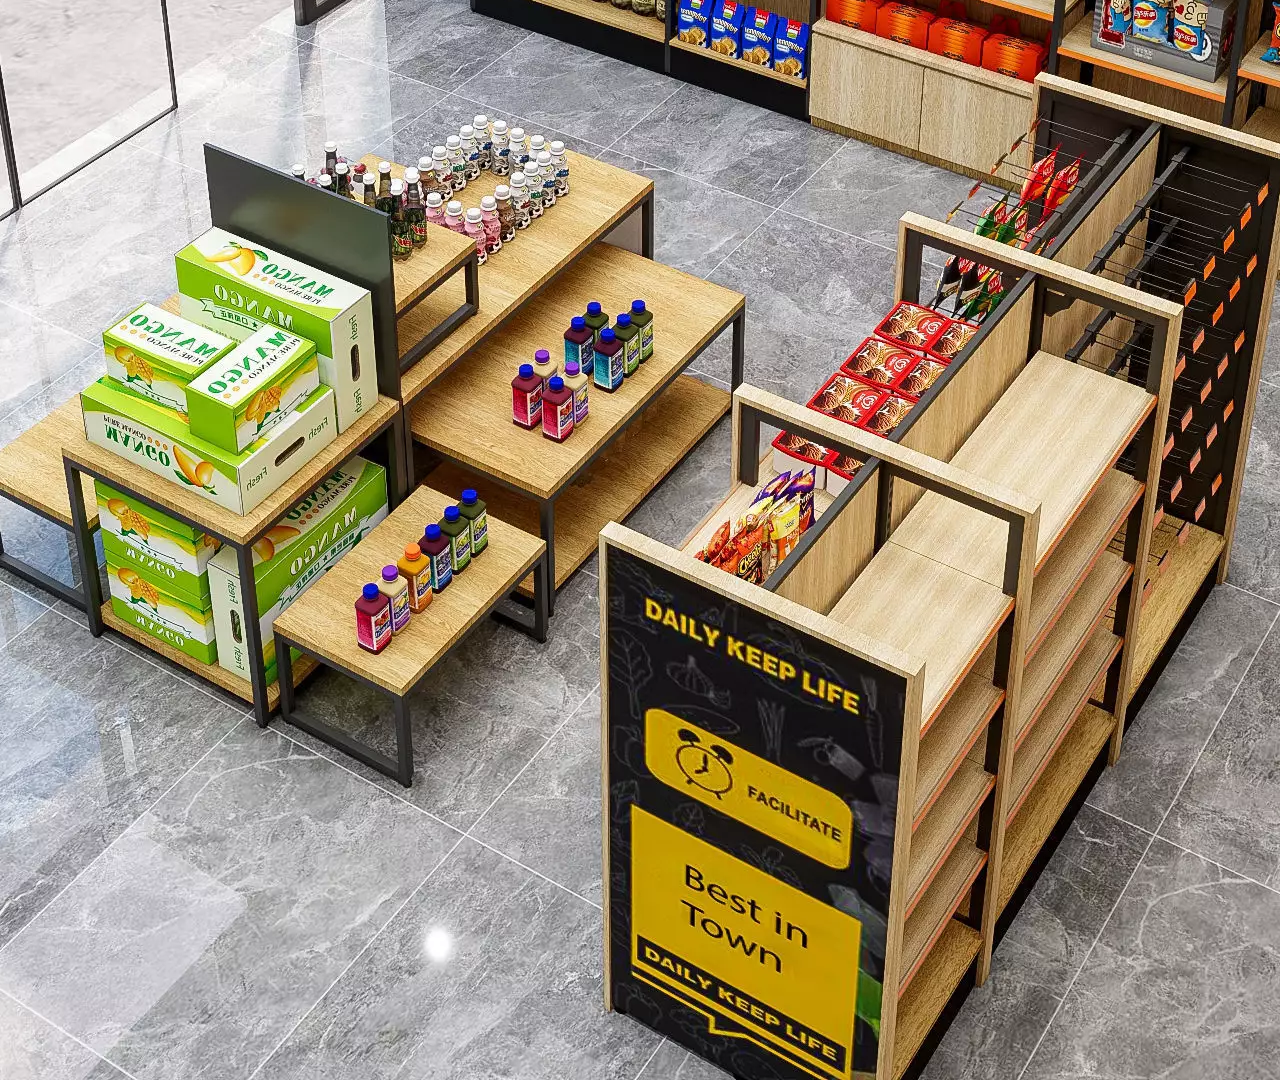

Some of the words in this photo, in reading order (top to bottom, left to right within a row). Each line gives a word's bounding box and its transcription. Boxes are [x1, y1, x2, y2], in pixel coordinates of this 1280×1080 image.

[645, 597, 719, 650] DAILY
[726, 635, 796, 680] KEEP
[802, 670, 860, 716] LIFE
[747, 784, 842, 844] FACILITATE
[681, 899, 783, 974] Town
[683, 864, 763, 924] Best
[774, 910, 809, 950] in
[645, 947, 712, 990] DAILY
[717, 981, 782, 1026] KEEP
[785, 1021, 838, 1061] LIFE
